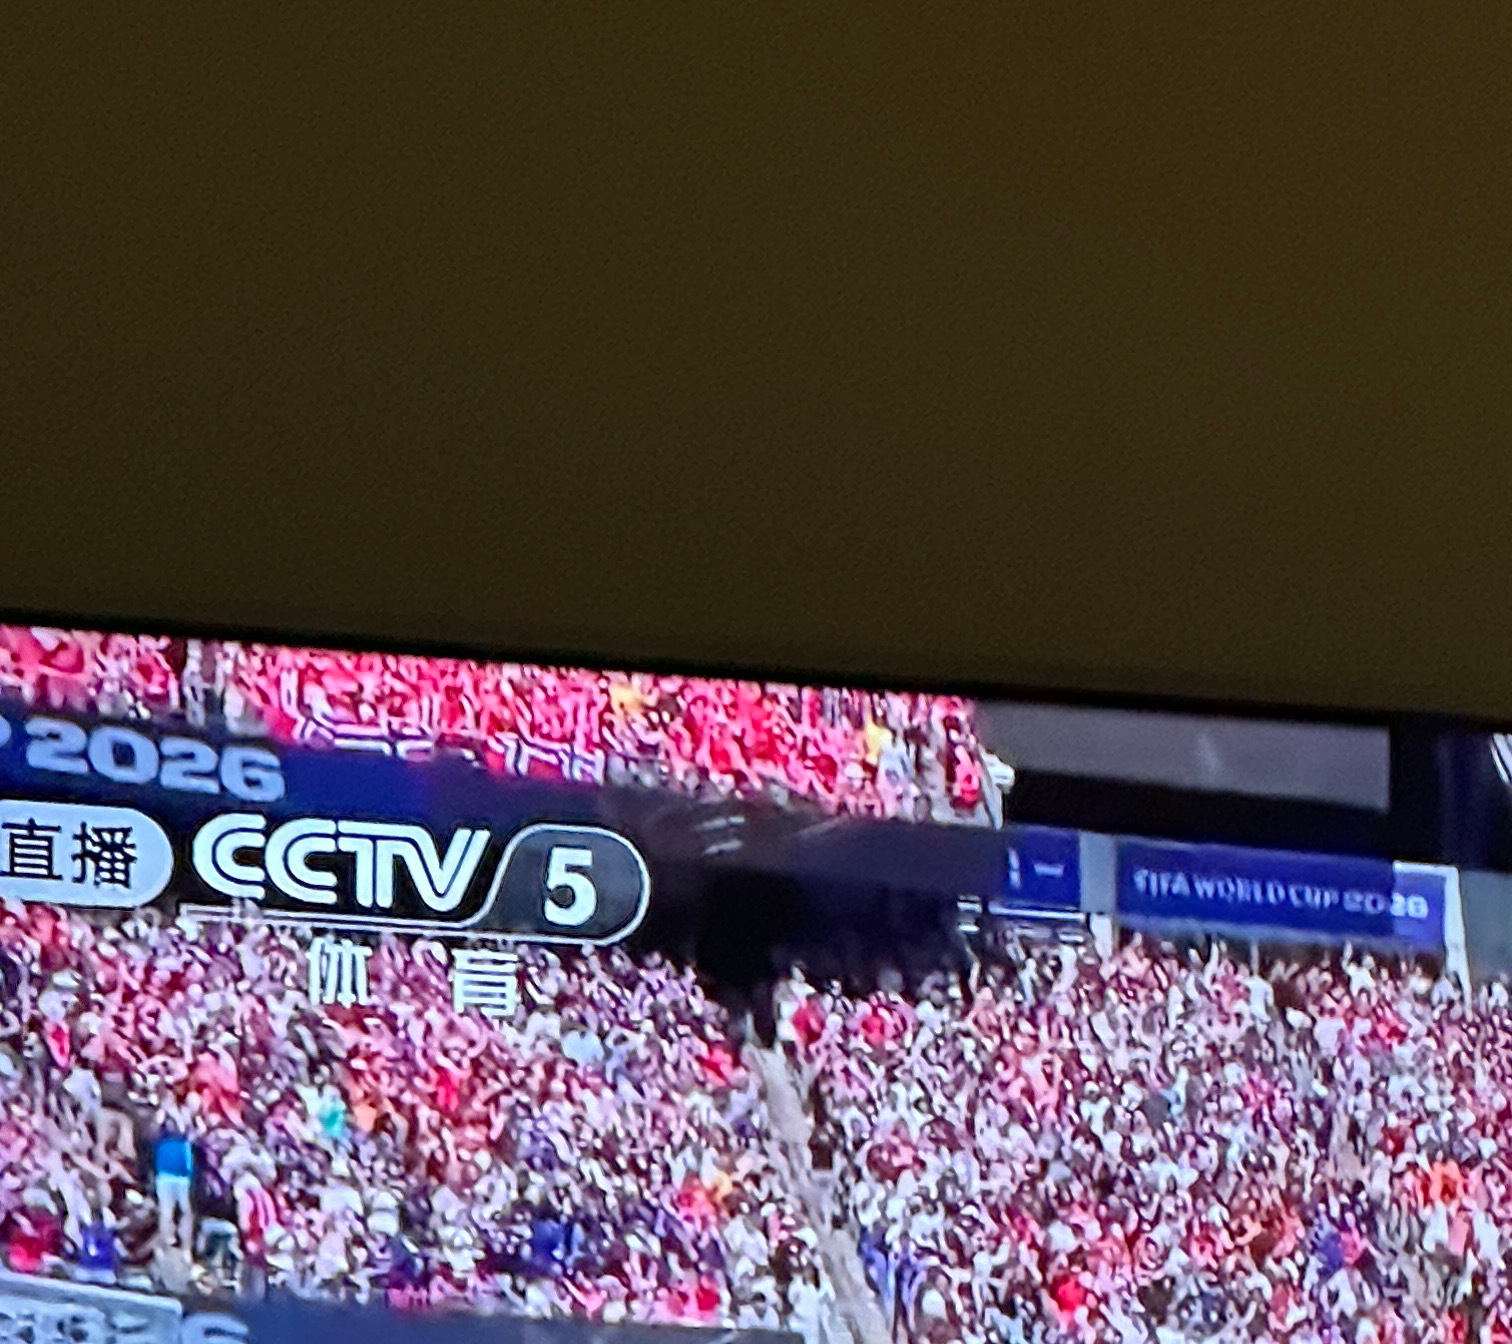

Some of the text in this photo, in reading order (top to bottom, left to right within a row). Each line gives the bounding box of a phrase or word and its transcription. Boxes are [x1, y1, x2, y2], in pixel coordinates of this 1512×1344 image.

[25, 715, 286, 802] 2026
[0, 817, 138, 890] 直播
[192, 813, 598, 927] CCTV 5
[1133, 868, 1190, 898] FIFA
[1193, 873, 1286, 905] WORLD
[1289, 883, 1339, 910] CUP
